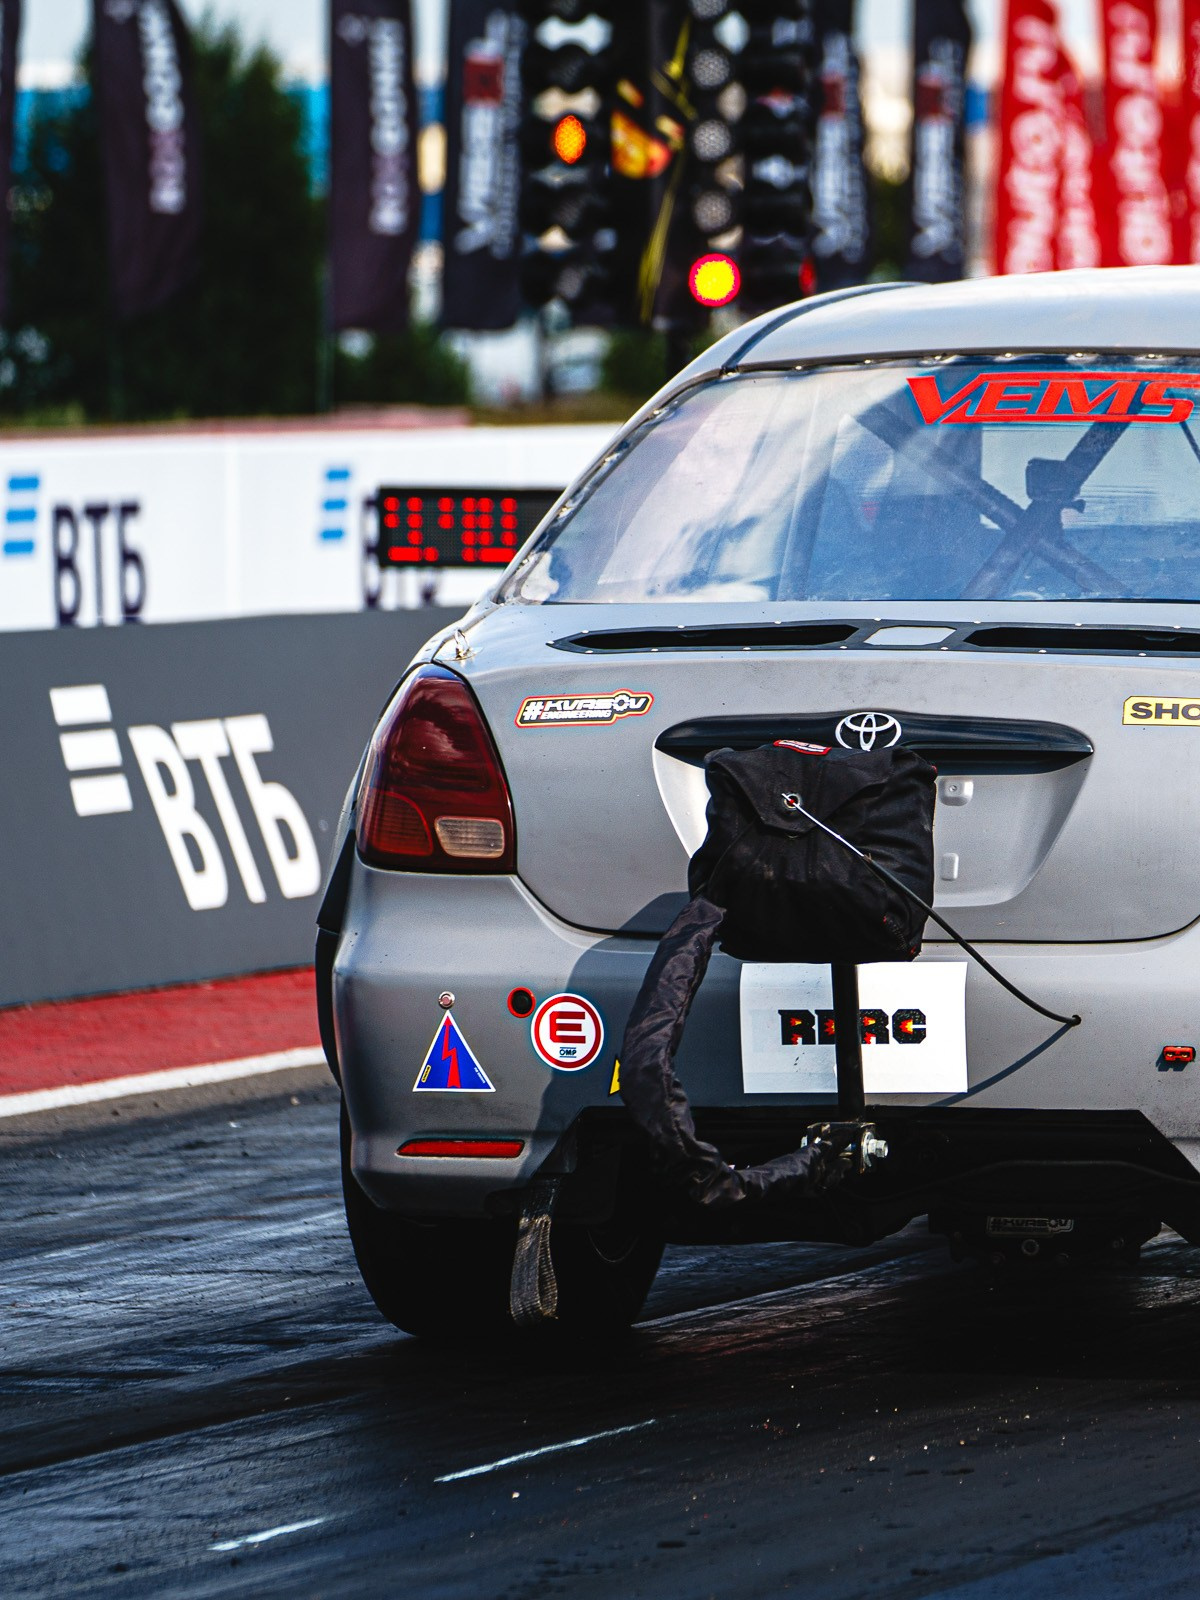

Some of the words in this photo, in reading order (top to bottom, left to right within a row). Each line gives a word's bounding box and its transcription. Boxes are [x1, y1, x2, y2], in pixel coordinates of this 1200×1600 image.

[52, 502, 147, 625] ВТБ
[127, 713, 322, 911] ВТБ
[559, 1048, 577, 1056] OMP
